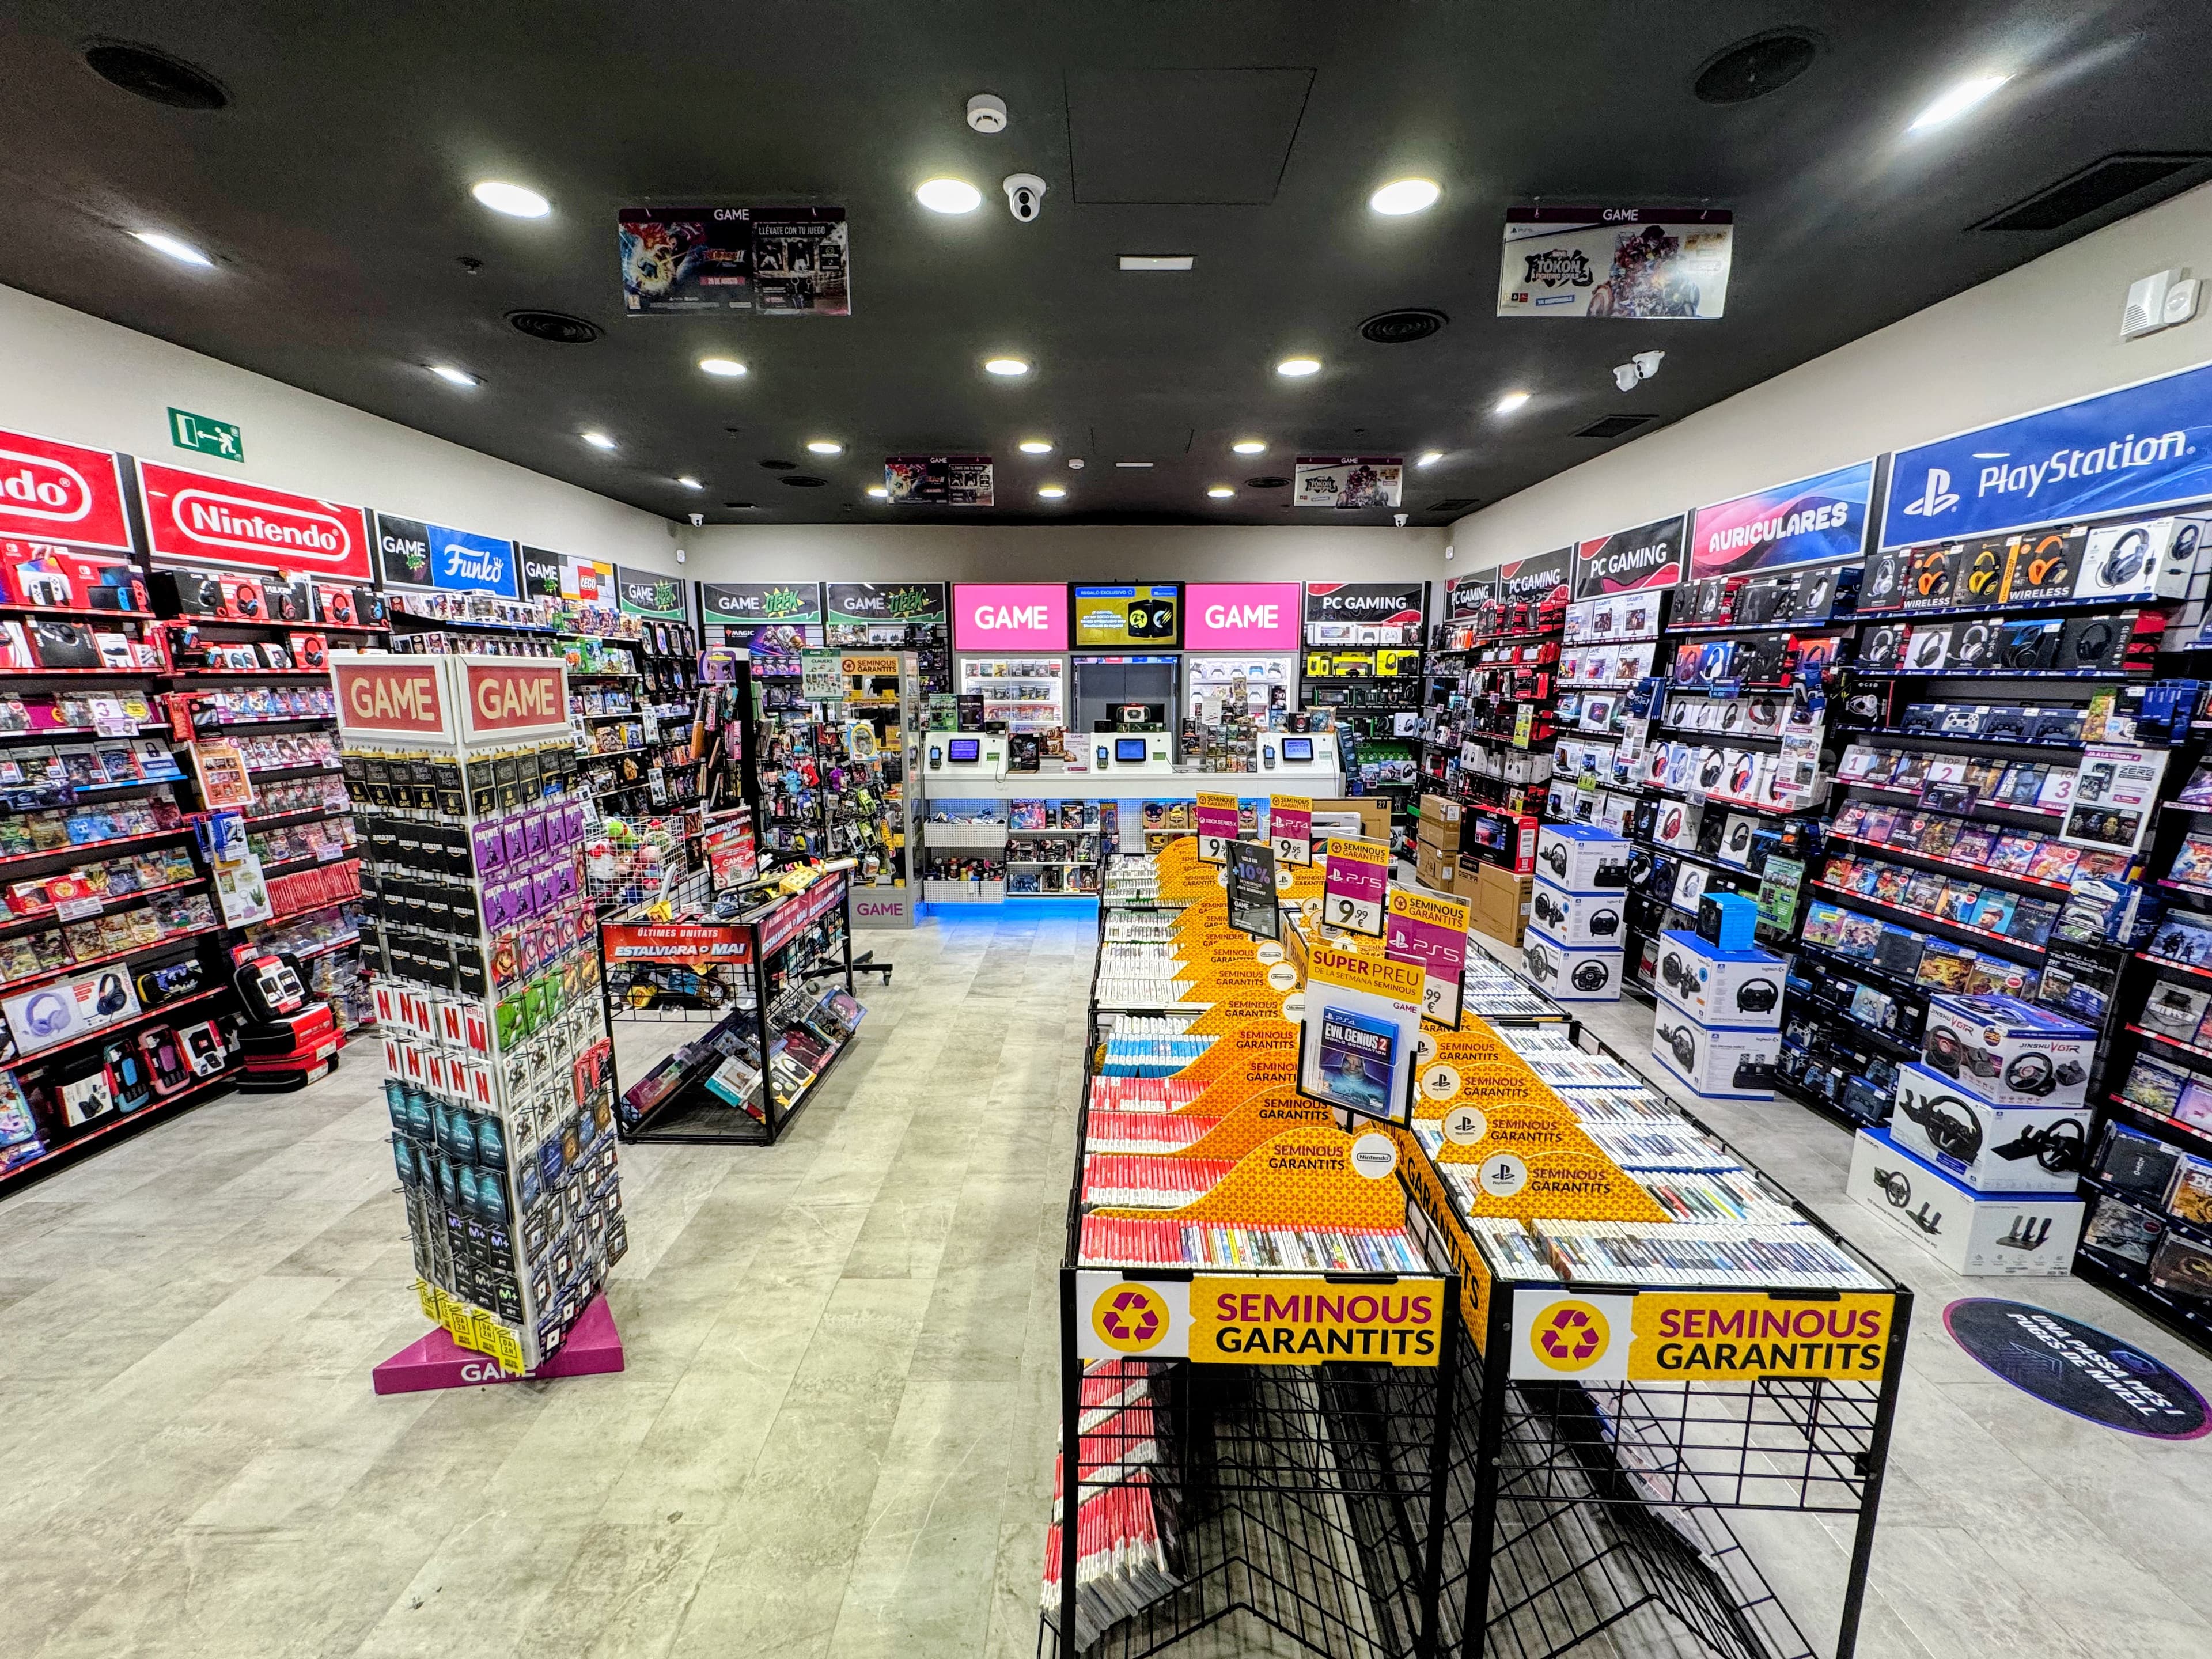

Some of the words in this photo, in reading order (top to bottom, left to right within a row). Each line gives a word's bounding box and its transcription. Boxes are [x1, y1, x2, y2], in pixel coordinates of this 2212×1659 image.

[714, 209, 749, 221] GAME
[1603, 209, 1638, 221] GAME
[759, 226, 783, 235] LLÉVATE
[785, 226, 797, 235] CON
[798, 226, 806, 234] TU
[808, 226, 825, 234] JUEGO
[1978, 430, 2186, 497] PlayStation
[191, 503, 336, 550] Nintendo
[1709, 501, 1848, 553] AURICULARES
[383, 536, 425, 556] GAME
[444, 544, 501, 582] Funko
[1590, 558, 1605, 578] PC
[1608, 543, 1667, 574] GAMING
[526, 562, 557, 579] GAME
[581, 577, 596, 589] LEGO
[1509, 579, 1520, 594] PC
[1521, 569, 1560, 592] GAMING
[629, 584, 653, 599] GAME
[1452, 593, 1460, 605] PC
[1460, 585, 1489, 604] GAMING
[2009, 587, 2070, 600] WIRELESS
[719, 597, 759, 610] GAME
[764, 590, 799, 615] GEEK
[844, 597, 884, 611] GAME
[889, 590, 923, 615] GEEK
[1323, 597, 1344, 609] PC
[1351, 596, 1407, 610] GAMING
[1904, 597, 1950, 609] WIRELESS
[975, 605, 1048, 630] GAME
[1205, 605, 1278, 628] GAME
[351, 677, 435, 721] GAME
[477, 678, 555, 721] GAME
[1849, 757, 1858, 771] 1
[1941, 767, 1952, 782] 2
[2055, 781, 2071, 798] 3
[480, 804, 495, 813] GAME
[1207, 801, 1236, 809] GARANTITS
[1281, 802, 1309, 810] GARANTITS
[706, 815, 751, 836] ESTALVIARA
[1286, 820, 1309, 829] PS4
[475, 827, 499, 843] FORTNITE
[722, 828, 740, 840] MAI
[447, 846, 467, 854] amazon
[1343, 843, 1385, 856] SEMINOUS
[723, 855, 744, 866] GAME
[1343, 851, 1385, 863] GARANTITS
[1233, 862, 1270, 884] +10%
[508, 877, 529, 892] FORTNITE
[1347, 874, 1382, 888] PS5
[427, 902, 448, 910] amazon
[453, 907, 474, 915] amazon
[857, 903, 903, 916] GAME
[1234, 901, 1249, 910] GAME
[1410, 898, 1464, 919] SEMINOUS
[1358, 918, 1364, 928] €
[1409, 907, 1463, 928] GARANTITS
[638, 927, 676, 937] ÚLTIMES
[680, 929, 718, 938] UNITATS
[615, 945, 697, 956] ESTALVIARA
[711, 944, 746, 956] MAI
[1413, 938, 1461, 964] PS5
[1313, 949, 1369, 976] SÚPER
[1372, 964, 1419, 986] PREU
[2049, 952, 2115, 975] TEMPORADA
[1315, 967, 1324, 975] DE
[1326, 969, 1335, 977] LA
[1336, 971, 1372, 987] SETMANA
[1373, 980, 1416, 996] SEMINOUS
[377, 989, 392, 1021] N
[399, 991, 414, 1025] N
[1393, 1002, 1418, 1014] GAME
[1428, 1002, 1435, 1013] €
[415, 999, 430, 1033] N
[466, 1006, 484, 1018] NETFLIX
[1225, 1009, 1278, 1017] GARANTITS
[1930, 1009, 1952, 1022] JINSHU
[444, 1006, 459, 1040] N
[1335, 1016, 1355, 1026] PS4
[1240, 1031, 1293, 1040] SEMINOUS
[1236, 1040, 1295, 1049] GARANTITS
[1324, 1037, 1346, 1047] WORLD
[1347, 1042, 1387, 1056] DOMINATION
[1377, 1038, 1387, 1051] 2
[1440, 1043, 1495, 1051] SEMINOUS
[2056, 1045, 2080, 1054] GTR
[1440, 1052, 1498, 1061] GARANTITS
[1465, 1077, 1524, 1086] SEMINOUS
[1464, 1088, 1528, 1097] GARANTITS
[1264, 1099, 1328, 1109] SEMINOUS
[1259, 1110, 1329, 1120] GARANTITS
[1492, 1120, 1557, 1130] SEMINOUS
[1491, 1131, 1562, 1142] GARANTITS
[1274, 1145, 1344, 1157] SEMINOUS
[1268, 1158, 1345, 1171] GARANTITS
[1532, 1168, 1605, 1181] SEMINOUS
[1532, 1181, 1611, 1194] GARANTITS
[491, 1236, 509, 1248] M+
[500, 1289, 517, 1301] M+
[1216, 1293, 1432, 1324] SEMINOUS
[483, 1323, 491, 1331] DA
[1658, 1309, 1881, 1339] SEMINOUS
[1215, 1327, 1435, 1356] GARANTITS
[1657, 1343, 1881, 1370] GARANTITS
[2031, 1314, 2071, 1339] UNA
[2066, 1340, 2129, 1378] PASSA
[2125, 1378, 2172, 1407] MÉS
[2006, 1313, 2066, 1350] PUGES
[2060, 1351, 2093, 1368] DE
[2085, 1369, 2157, 1416] NIVELL
